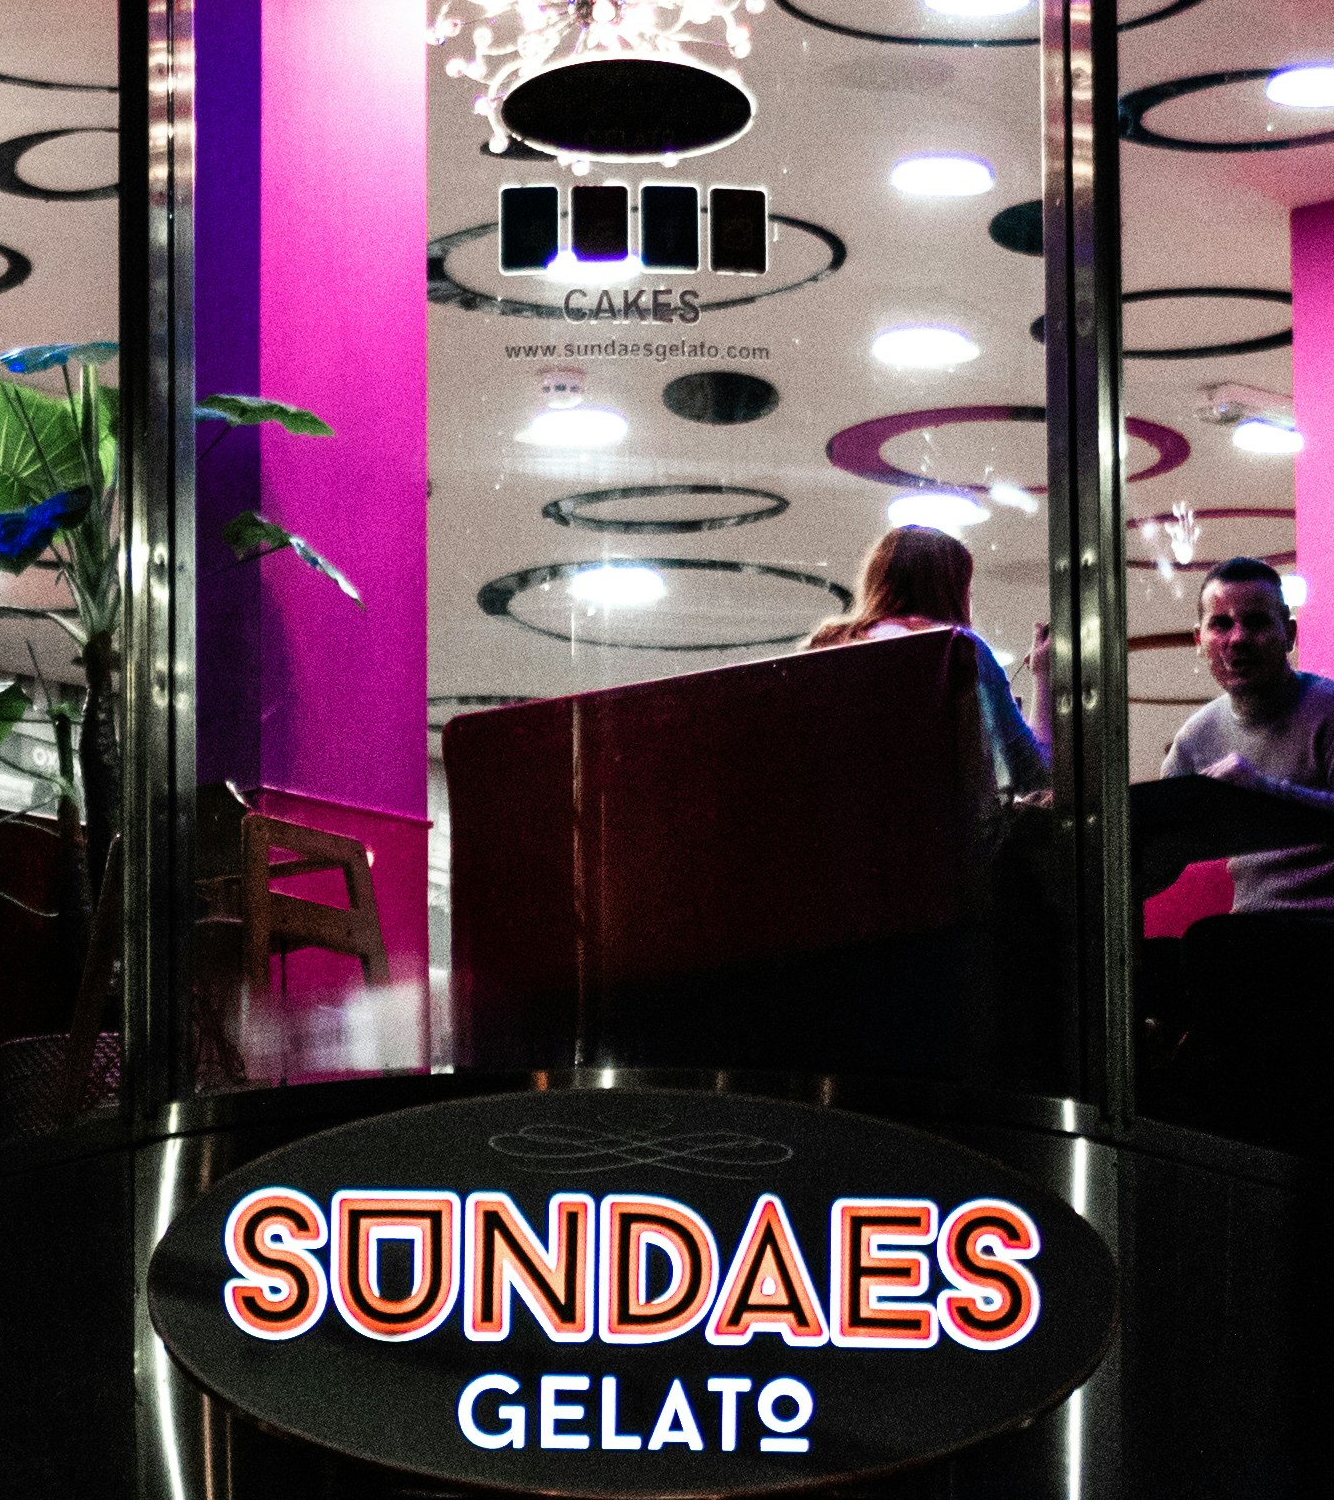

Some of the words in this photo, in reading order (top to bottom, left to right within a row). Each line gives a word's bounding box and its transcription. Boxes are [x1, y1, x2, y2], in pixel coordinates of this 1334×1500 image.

[563, 287, 701, 324] CAKES
[504, 339, 770, 362] www.sundaesgelato.com
[223, 1186, 1042, 1351] SUNDAES
[457, 1373, 814, 1453] GELATO
